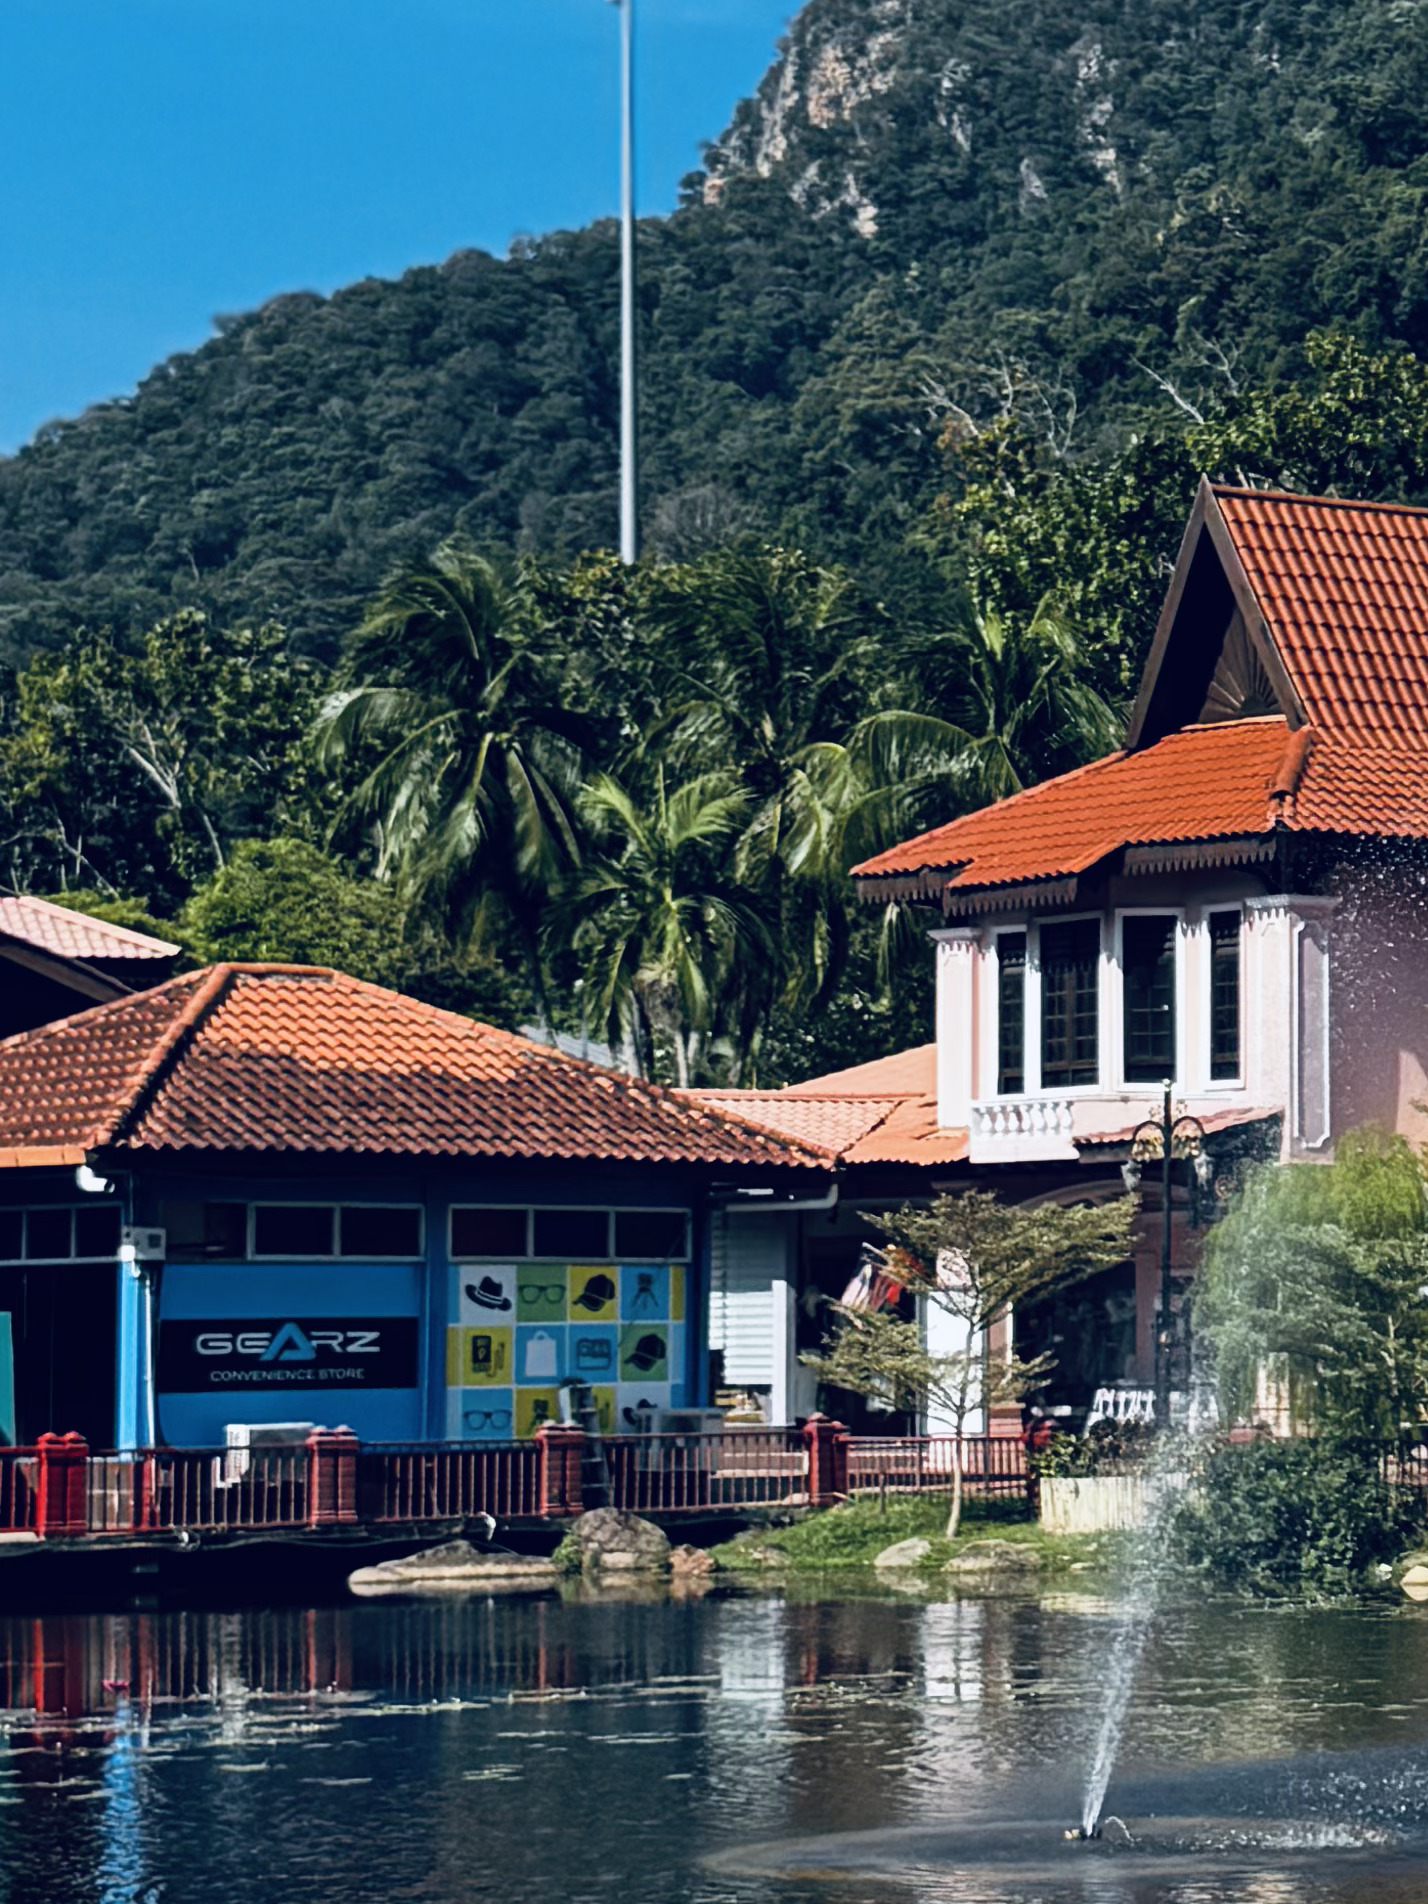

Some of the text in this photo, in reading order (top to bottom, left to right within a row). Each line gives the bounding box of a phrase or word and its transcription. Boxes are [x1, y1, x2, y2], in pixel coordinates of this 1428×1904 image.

[196, 1322, 381, 1361] GEARZ
[210, 1367, 365, 1382] CONVENIENCE STORE
